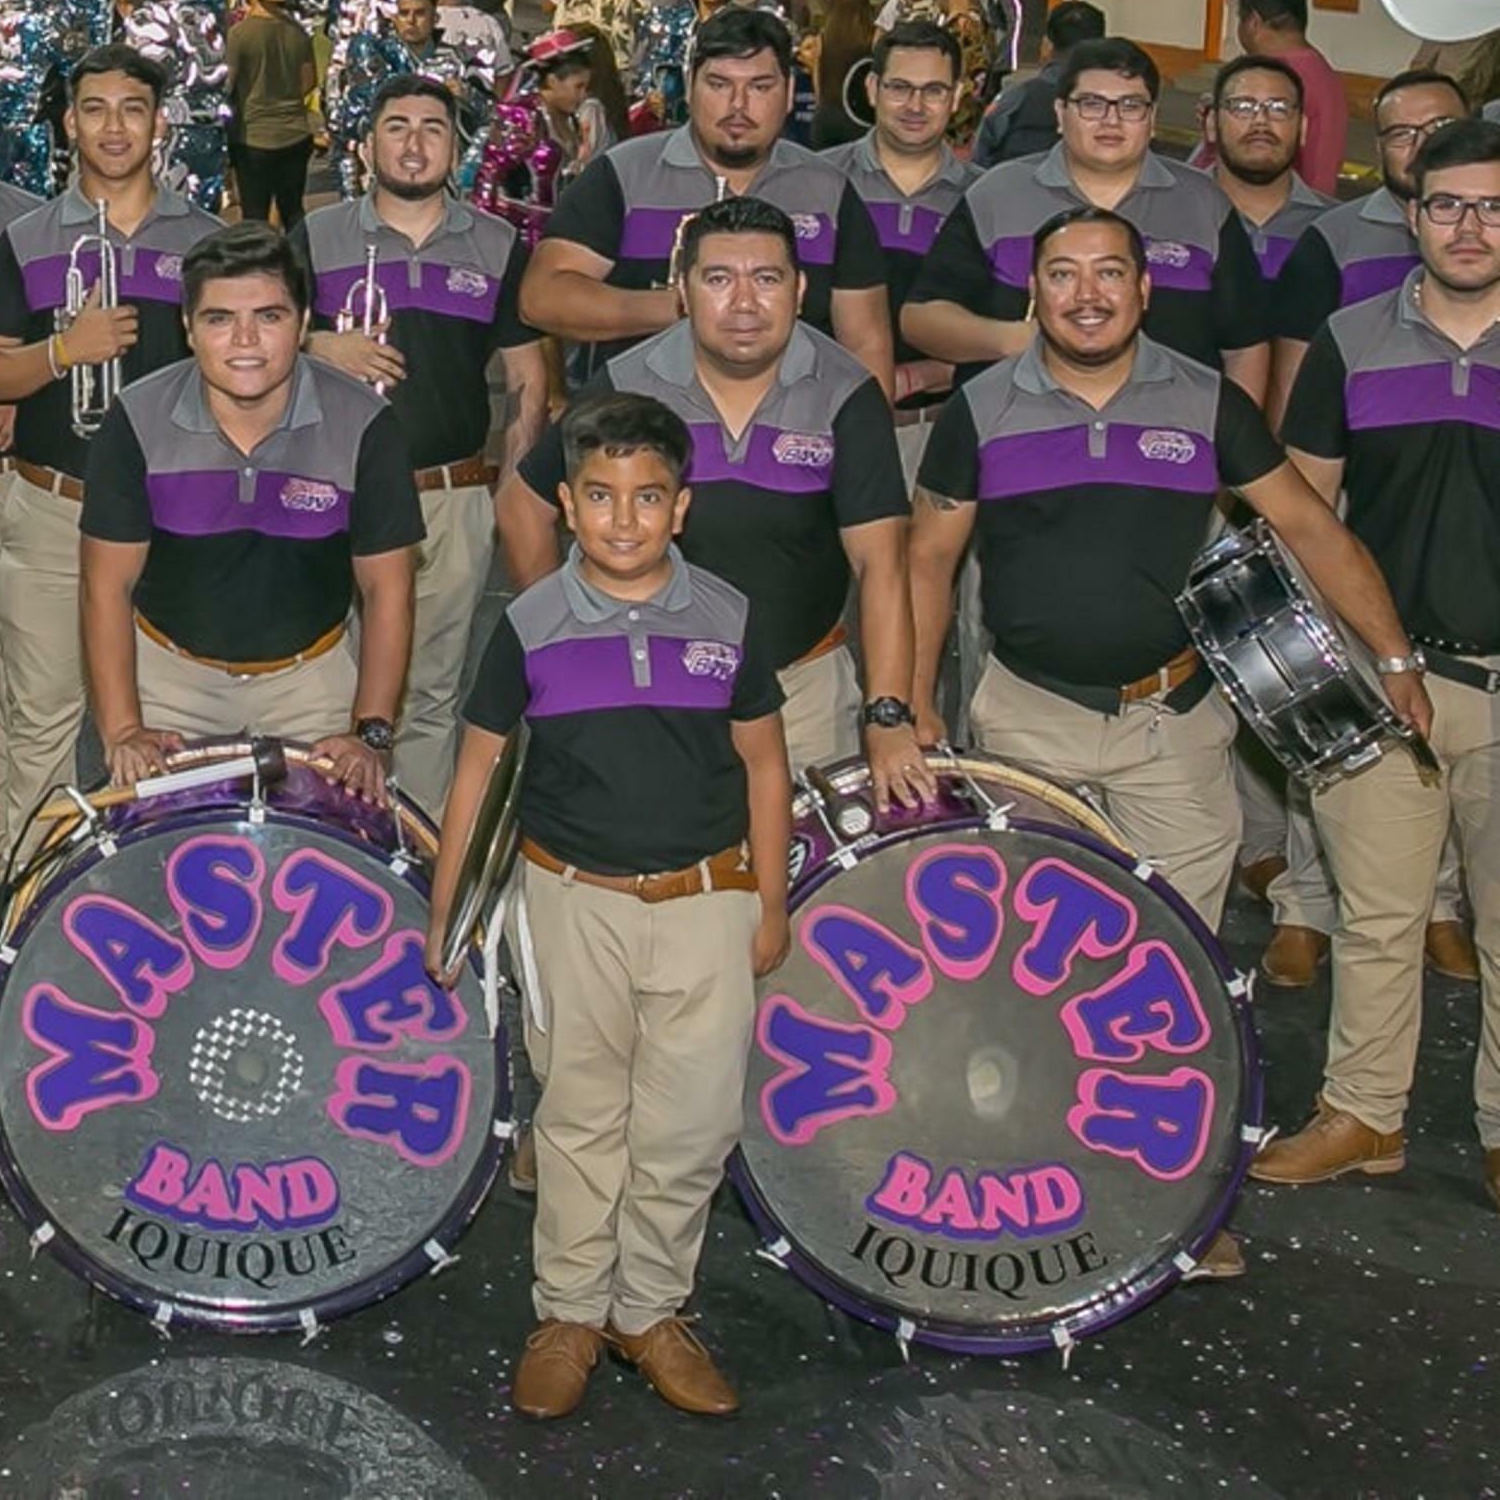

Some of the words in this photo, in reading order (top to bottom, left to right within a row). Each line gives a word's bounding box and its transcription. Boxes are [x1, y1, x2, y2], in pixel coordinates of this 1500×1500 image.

[23, 834, 472, 1167] MASTER
[757, 844, 1215, 1182] MASTER
[130, 1143, 339, 1228] BAND
[870, 1153, 1082, 1236] BAND
[104, 1207, 357, 1290] IQUIQUE
[848, 1223, 1109, 1298] IQUIQUE
